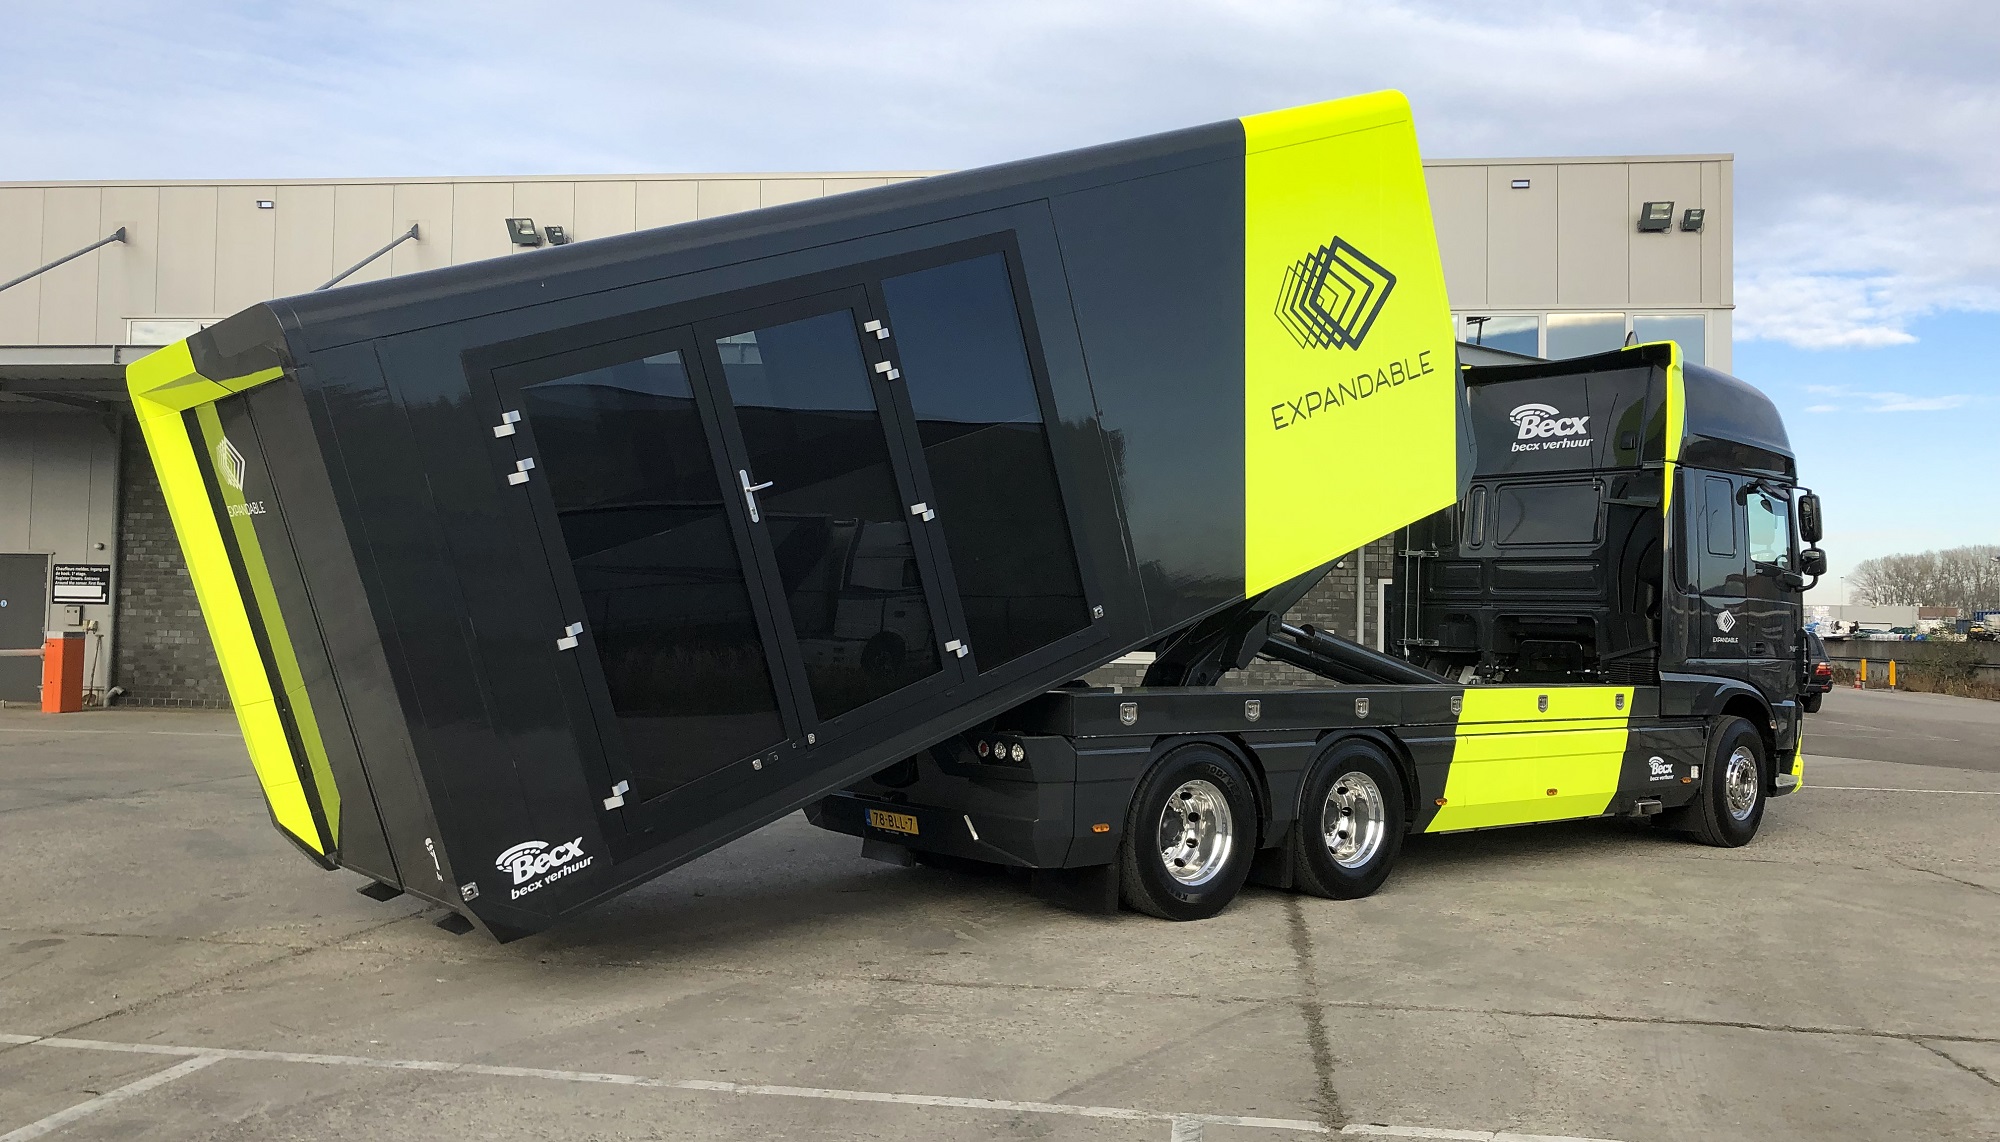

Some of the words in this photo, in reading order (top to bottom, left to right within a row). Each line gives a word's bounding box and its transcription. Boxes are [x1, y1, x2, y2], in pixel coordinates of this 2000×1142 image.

[1271, 350, 1434, 430] EXPANDABLE
[1517, 415, 1590, 439] Becx
[1511, 442, 1540, 452] becx
[1542, 438, 1593, 449] verhuur
[227, 501, 266, 517] EXPANDABLE
[1651, 763, 1673, 775] Becx
[873, 812, 913, 830] 78-BLL-7
[512, 836, 585, 885] Becx
[511, 879, 543, 900] becx
[545, 856, 594, 884] verhuur
